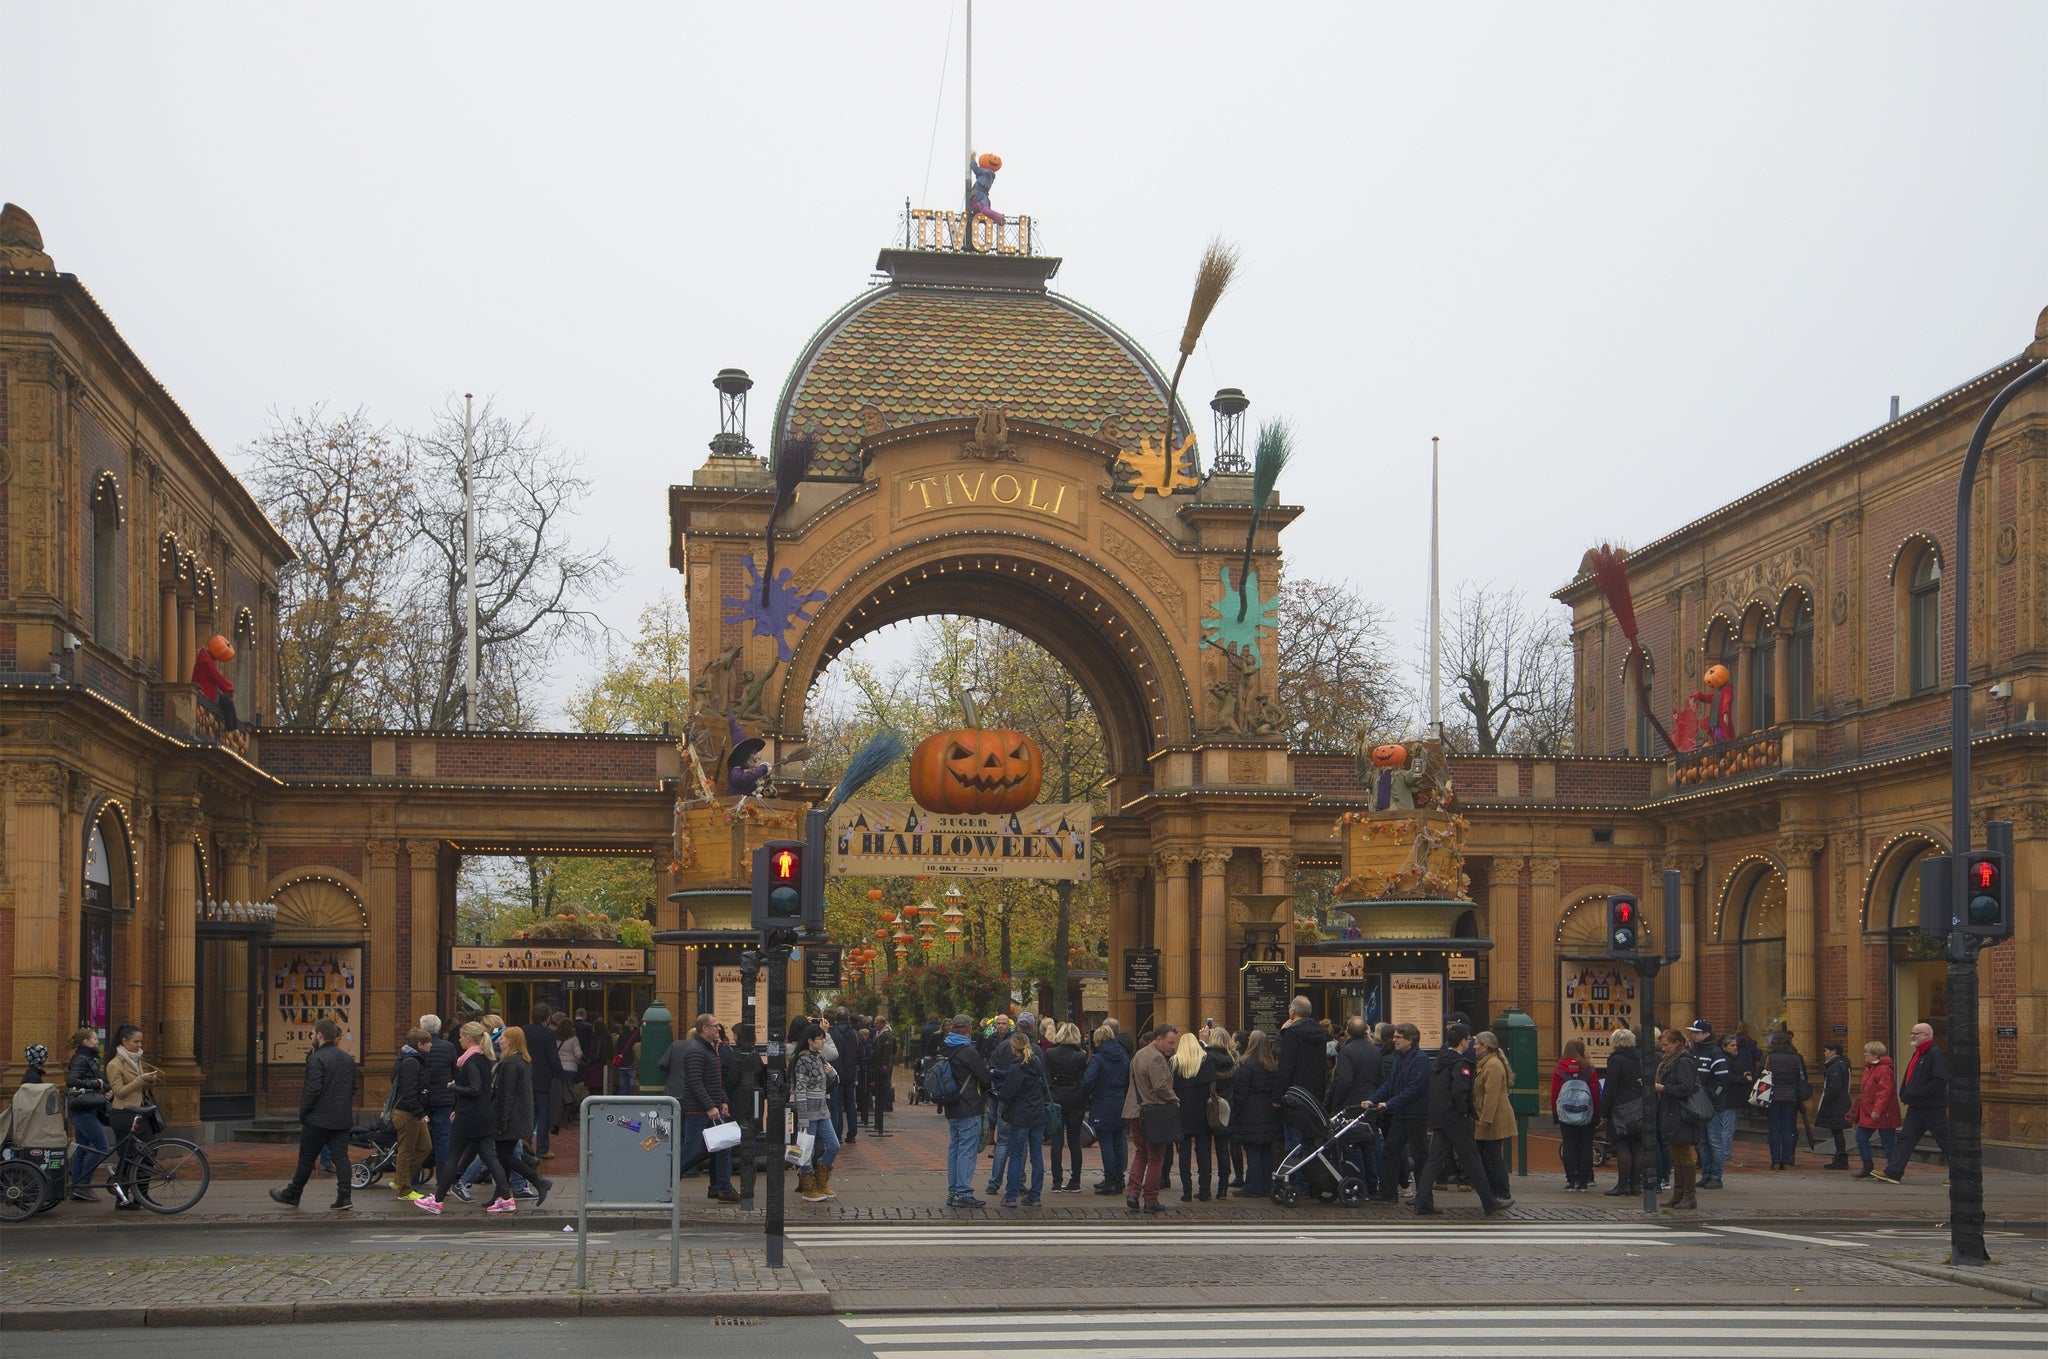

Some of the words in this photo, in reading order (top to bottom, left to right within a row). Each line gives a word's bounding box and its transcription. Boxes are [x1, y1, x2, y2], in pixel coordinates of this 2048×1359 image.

[912, 209, 1027, 255] TIVOLI
[908, 472, 1065, 514] TIVOLI
[939, 817, 947, 826] 3
[950, 818, 988, 827] UGER
[861, 833, 1066, 857] HALLOWEEN
[507, 959, 588, 969] HALLOWEEN
[1255, 965, 1279, 973] TIVOLI
[279, 993, 351, 1007] HALLO
[279, 1007, 350, 1023] WEEN
[1570, 1003, 1631, 1015] HALLO
[1570, 1016, 1631, 1030] WEEN
[286, 1031, 295, 1041] 3
